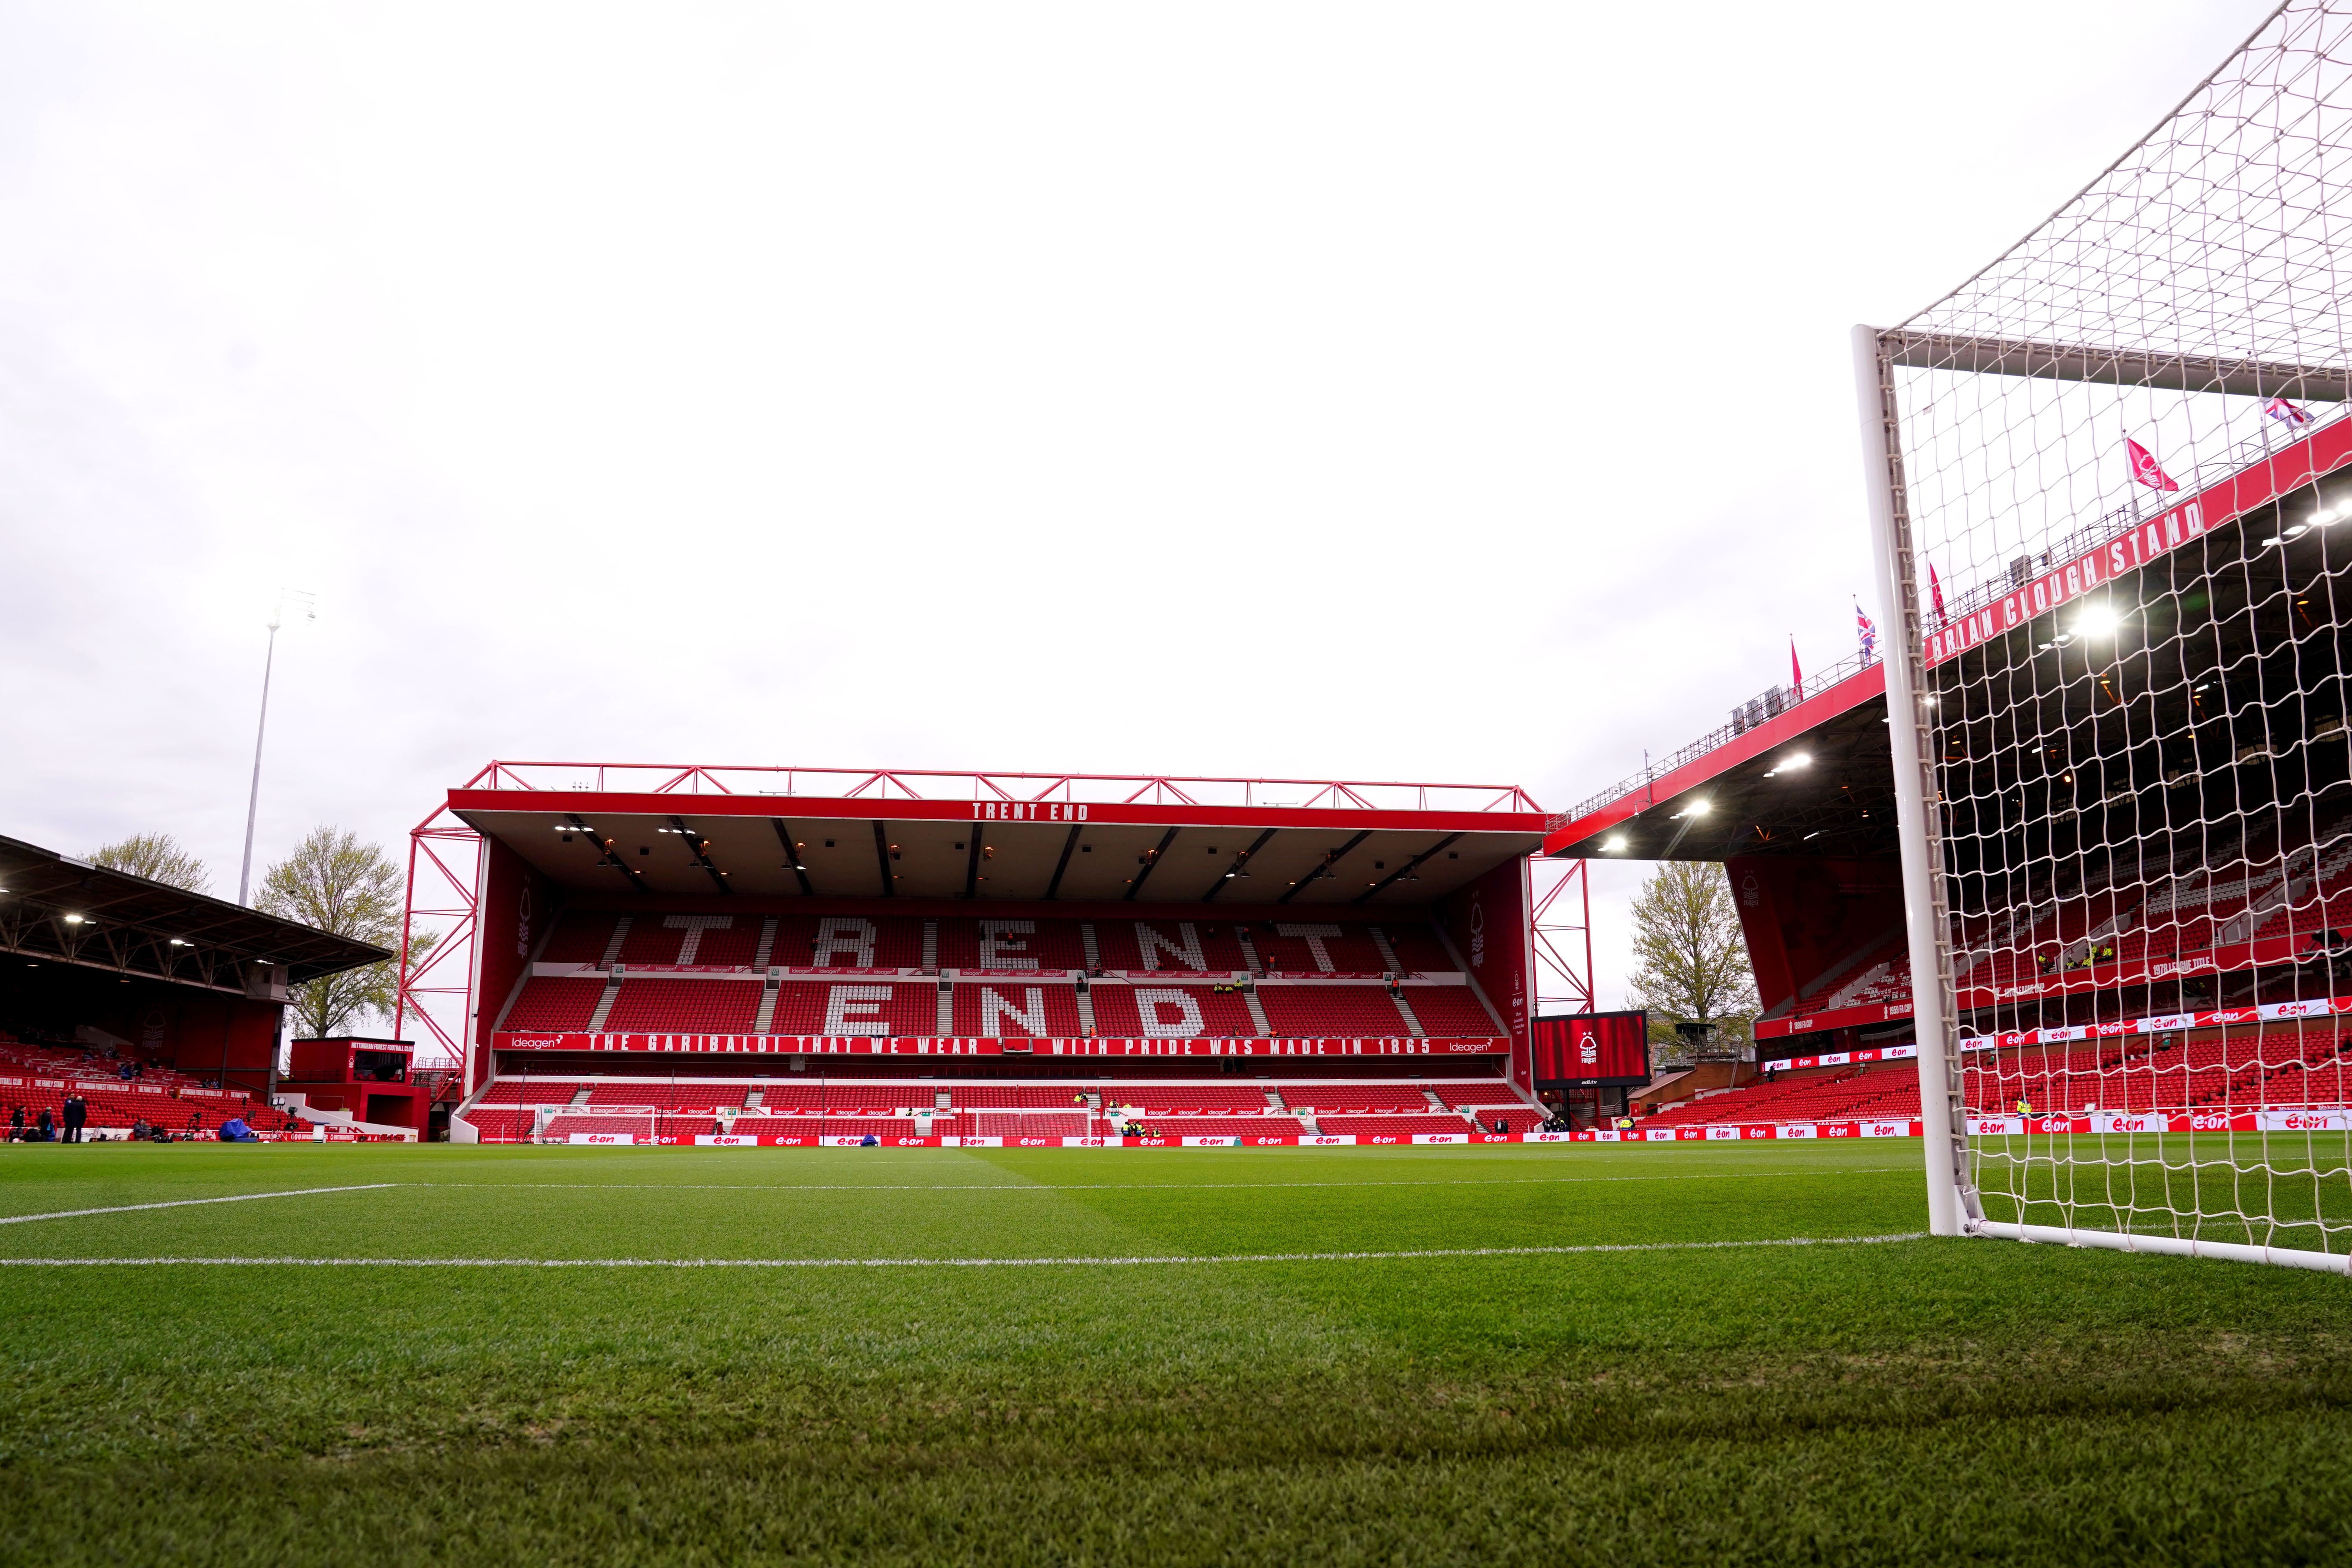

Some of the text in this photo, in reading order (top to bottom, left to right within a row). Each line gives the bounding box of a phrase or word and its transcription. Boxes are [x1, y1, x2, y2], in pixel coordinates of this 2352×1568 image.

[1931, 502, 2202, 663] BRIAN CLOUGH STAND
[973, 802, 1087, 820] TRENT END
[2153, 956, 2210, 975] 1978 LEGUE TITLE
[824, 985, 1205, 1037] END
[1889, 1006, 1899, 1015] 1959
[1899, 1005, 1904, 1014] FA
[1802, 1020, 1806, 1029] FA
[142, 1040, 163, 1049] FOREST
[512, 1035, 554, 1049] Ideagen
[589, 1034, 1429, 1054] THE GARIBALDI THAT WE WEAR WITH PRIDE WAS MADE IN 1865
[1450, 1042, 1487, 1053] Ideagen
